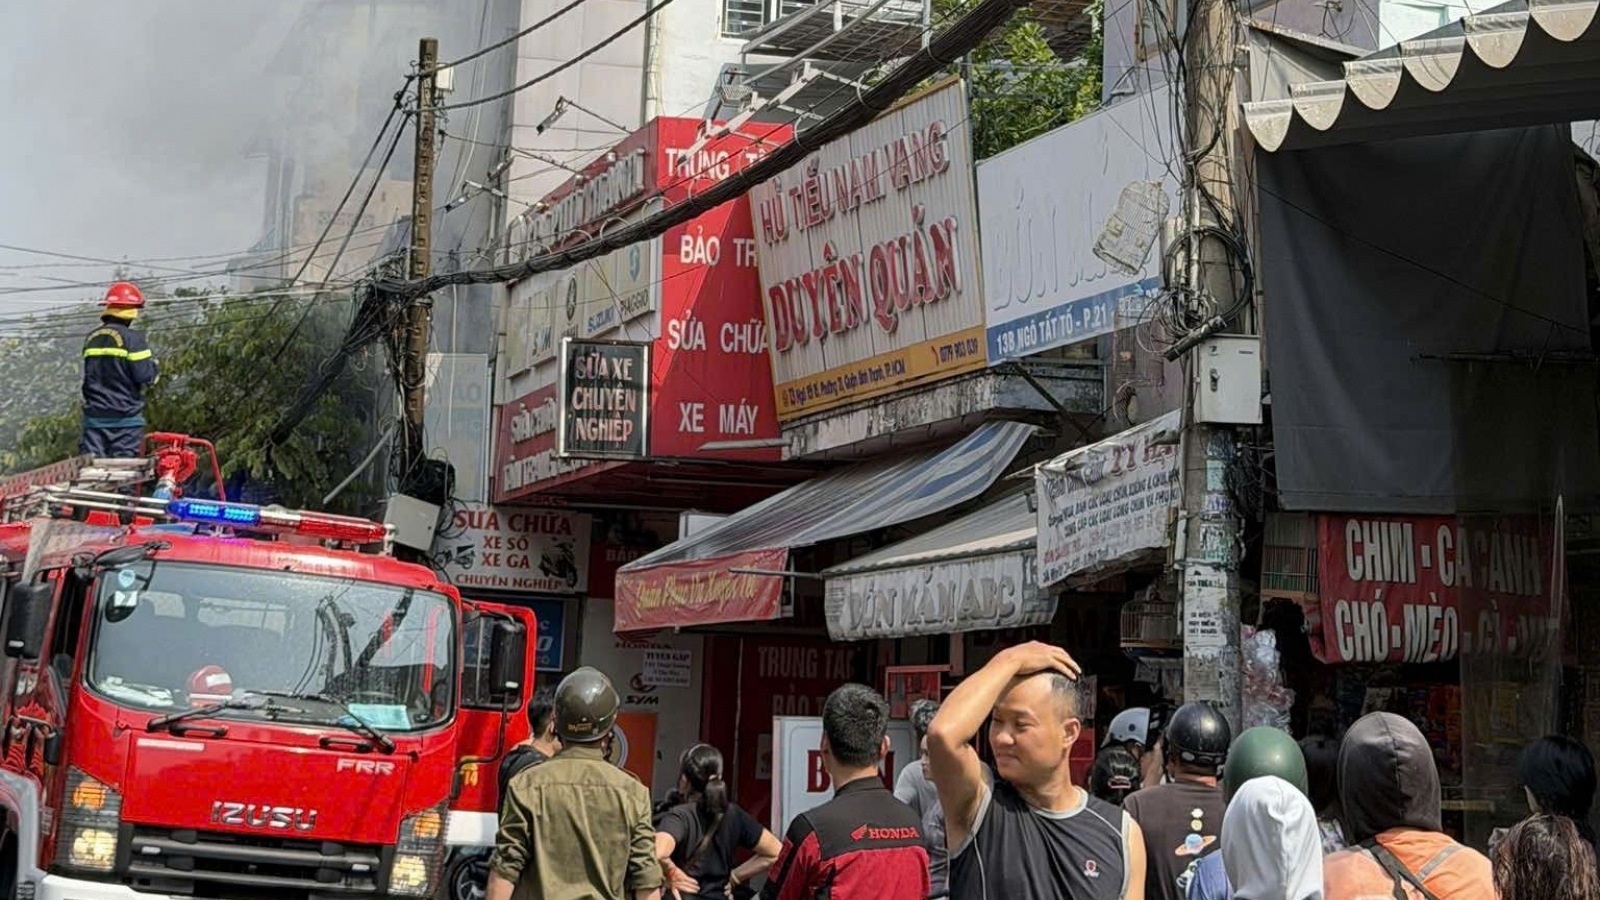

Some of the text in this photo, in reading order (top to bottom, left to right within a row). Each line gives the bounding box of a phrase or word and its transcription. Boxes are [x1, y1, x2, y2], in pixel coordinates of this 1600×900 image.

[666, 147, 730, 181] TRUNG
[834, 149, 887, 213] NAM
[885, 120, 950, 191] VANG
[681, 225, 760, 268] BẢO TR
[768, 204, 962, 352] DUYÊN QUÁN
[667, 310, 707, 350] SỬA
[996, 330, 1015, 355] 13B
[1016, 321, 1038, 349] NGÔ
[1039, 310, 1060, 342] TẤT
[1060, 304, 1074, 334] TỐ
[575, 352, 633, 381] SỬA XE
[572, 382, 636, 413] CHUYÊN
[575, 412, 633, 449] NGHIỆP
[679, 398, 759, 434] XE MÁY
[508, 511, 573, 535] CHỮA
[482, 533, 529, 551] XE SỐ
[1345, 518, 1416, 584] CHIM
[481, 552, 530, 569] XE GA
[456, 573, 563, 590] CHUYÊN NGHIỆP
[758, 646, 818, 679] TRUNG
[625, 695, 659, 705] SYM
[336, 758, 395, 777] FRR
[868, 825, 919, 840] HONDA
